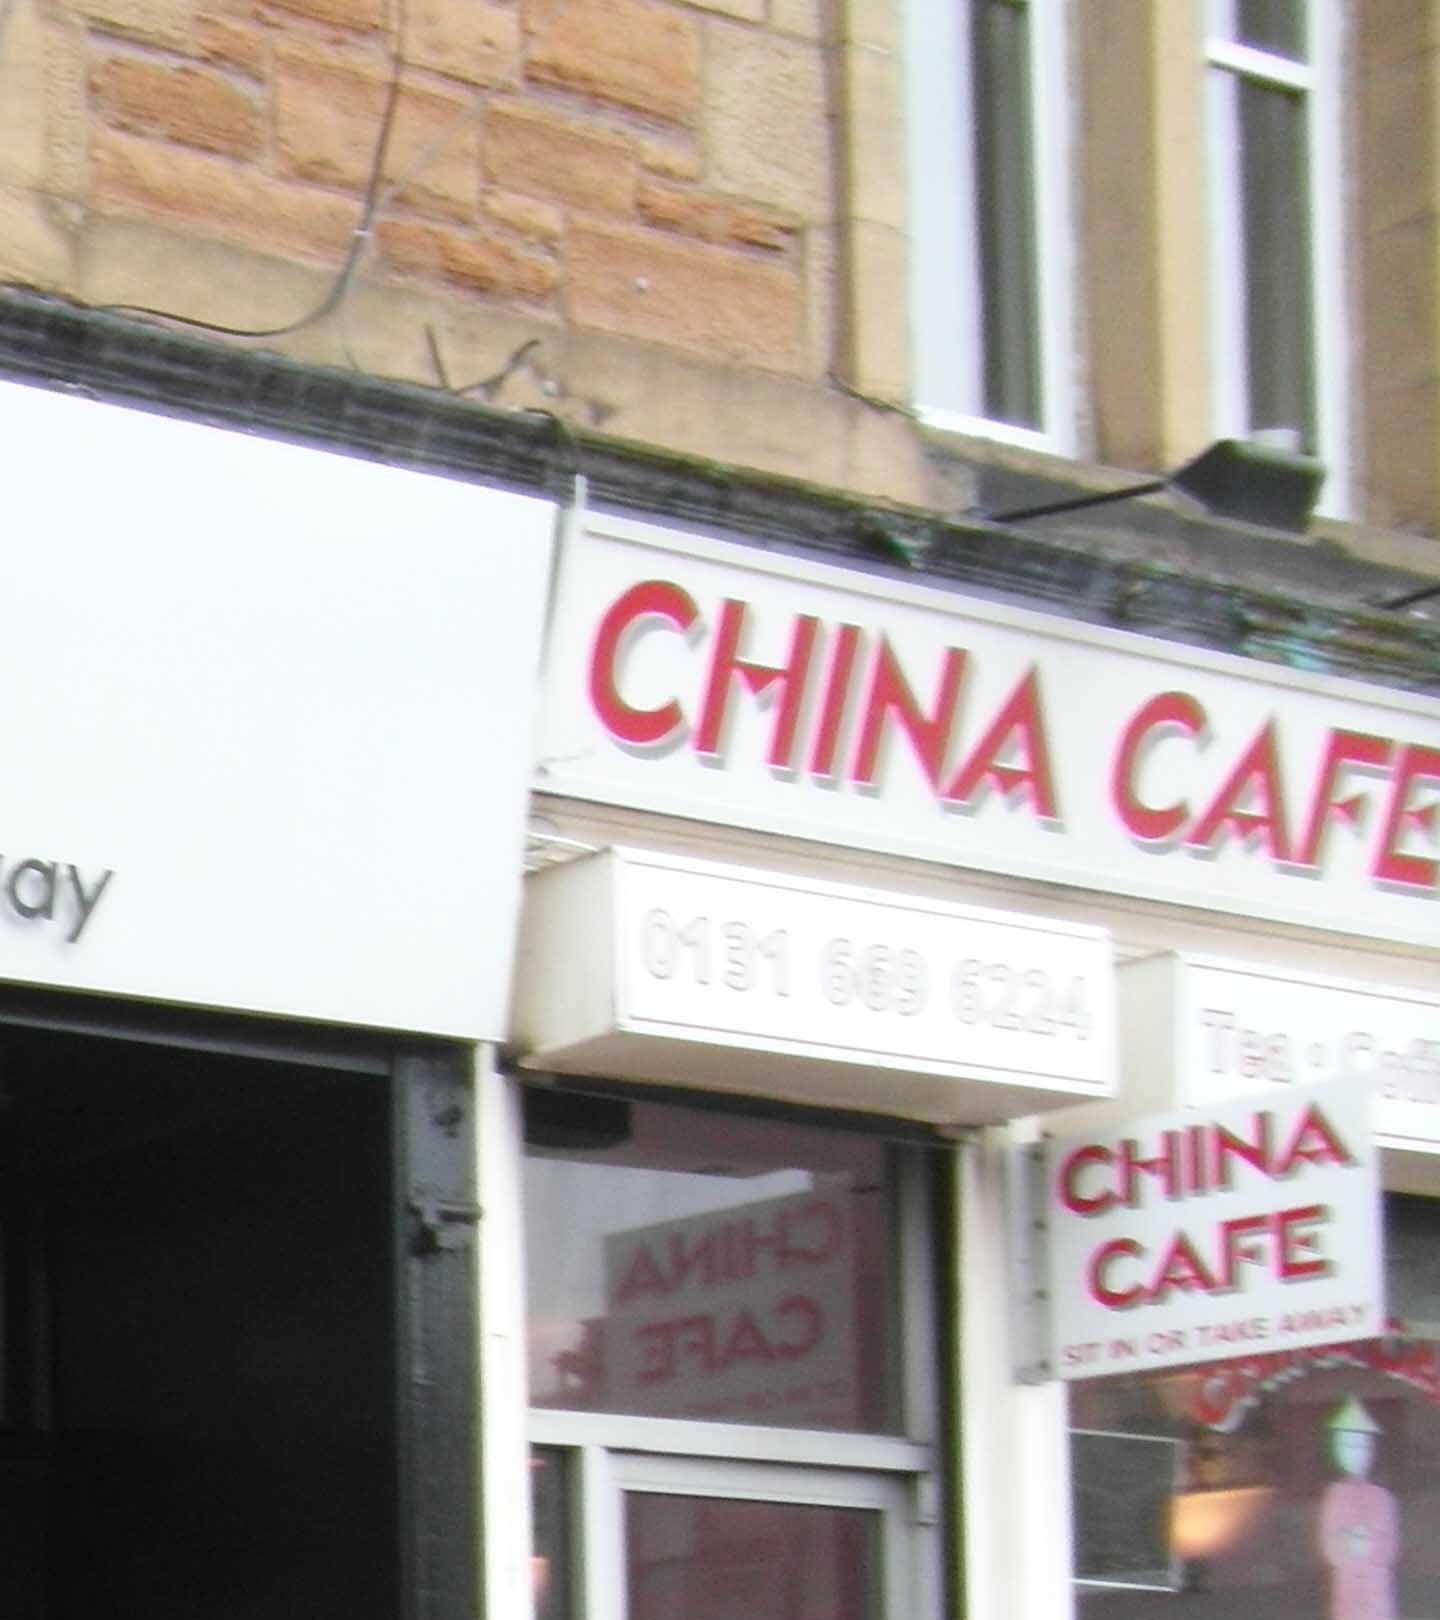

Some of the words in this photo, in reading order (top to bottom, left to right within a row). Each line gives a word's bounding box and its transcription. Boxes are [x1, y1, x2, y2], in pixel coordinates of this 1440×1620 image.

[587, 579, 1058, 828] CHINA
[1108, 690, 1440, 892] CAFE
[643, 908, 791, 997] 0131
[819, 937, 931, 1017] 669
[1200, 1008, 1292, 1084] Tea
[1056, 1102, 1360, 1216] CHINA
[1084, 1204, 1337, 1312] CAFE
[1194, 1317, 1271, 1346] TAKE
